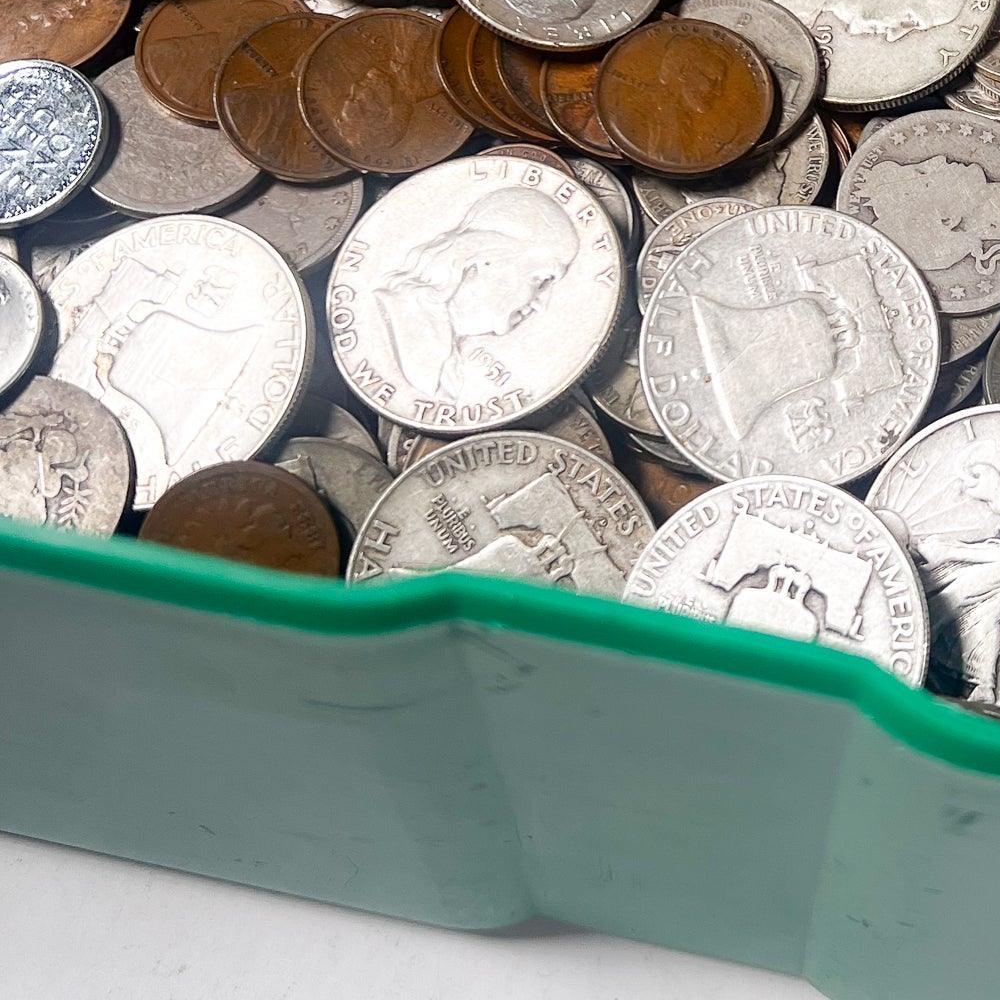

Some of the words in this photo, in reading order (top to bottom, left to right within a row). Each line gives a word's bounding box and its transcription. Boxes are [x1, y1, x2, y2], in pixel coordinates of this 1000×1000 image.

[112, 222, 244, 260] AMERICA
[344, 239, 369, 272] IN
[468, 160, 618, 288] LIBERTY
[746, 211, 857, 242] UNITED
[331, 283, 359, 351] GOD
[647, 248, 715, 358] HALF
[859, 236, 932, 330] STATES
[247, 271, 300, 432] DOLLAR
[351, 358, 397, 407] WE
[914, 333, 934, 370] OF
[414, 388, 526, 426] TRUST
[819, 367, 930, 477] AMERICA
[421, 440, 538, 488] UNITED
[547, 448, 644, 537] STATES
[431, 492, 477, 552] PLURIBUS
[632, 500, 721, 598] UNITED
[732, 483, 845, 525] STATES
[847, 512, 880, 546] OF
